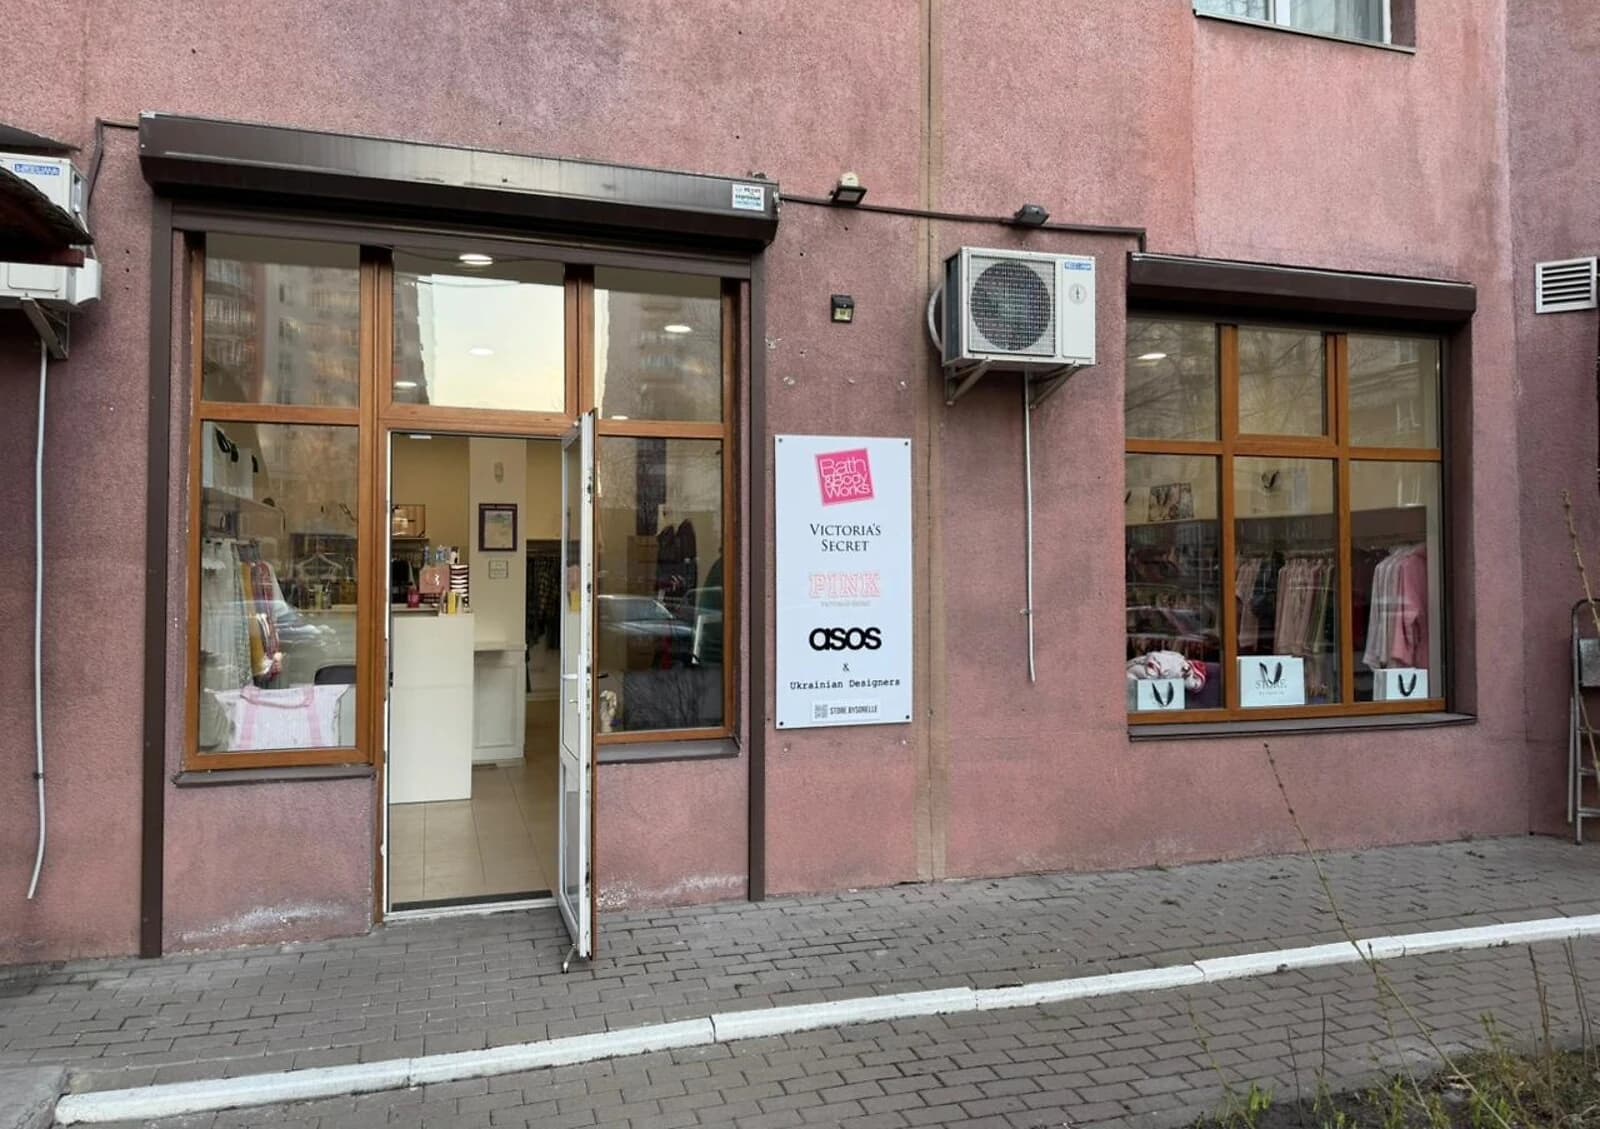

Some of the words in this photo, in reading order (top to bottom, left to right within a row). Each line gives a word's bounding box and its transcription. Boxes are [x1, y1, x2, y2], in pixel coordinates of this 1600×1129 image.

[820, 457, 867, 477] Bath
[825, 484, 871, 498] Works
[810, 522, 881, 536] VICTORIA'S
[821, 539, 869, 552] SECRET
[809, 573, 881, 598] PINK
[809, 627, 882, 651] asos
[842, 662, 850, 672] &
[790, 680, 844, 690] Ukrainian
[849, 678, 900, 688] Designers
